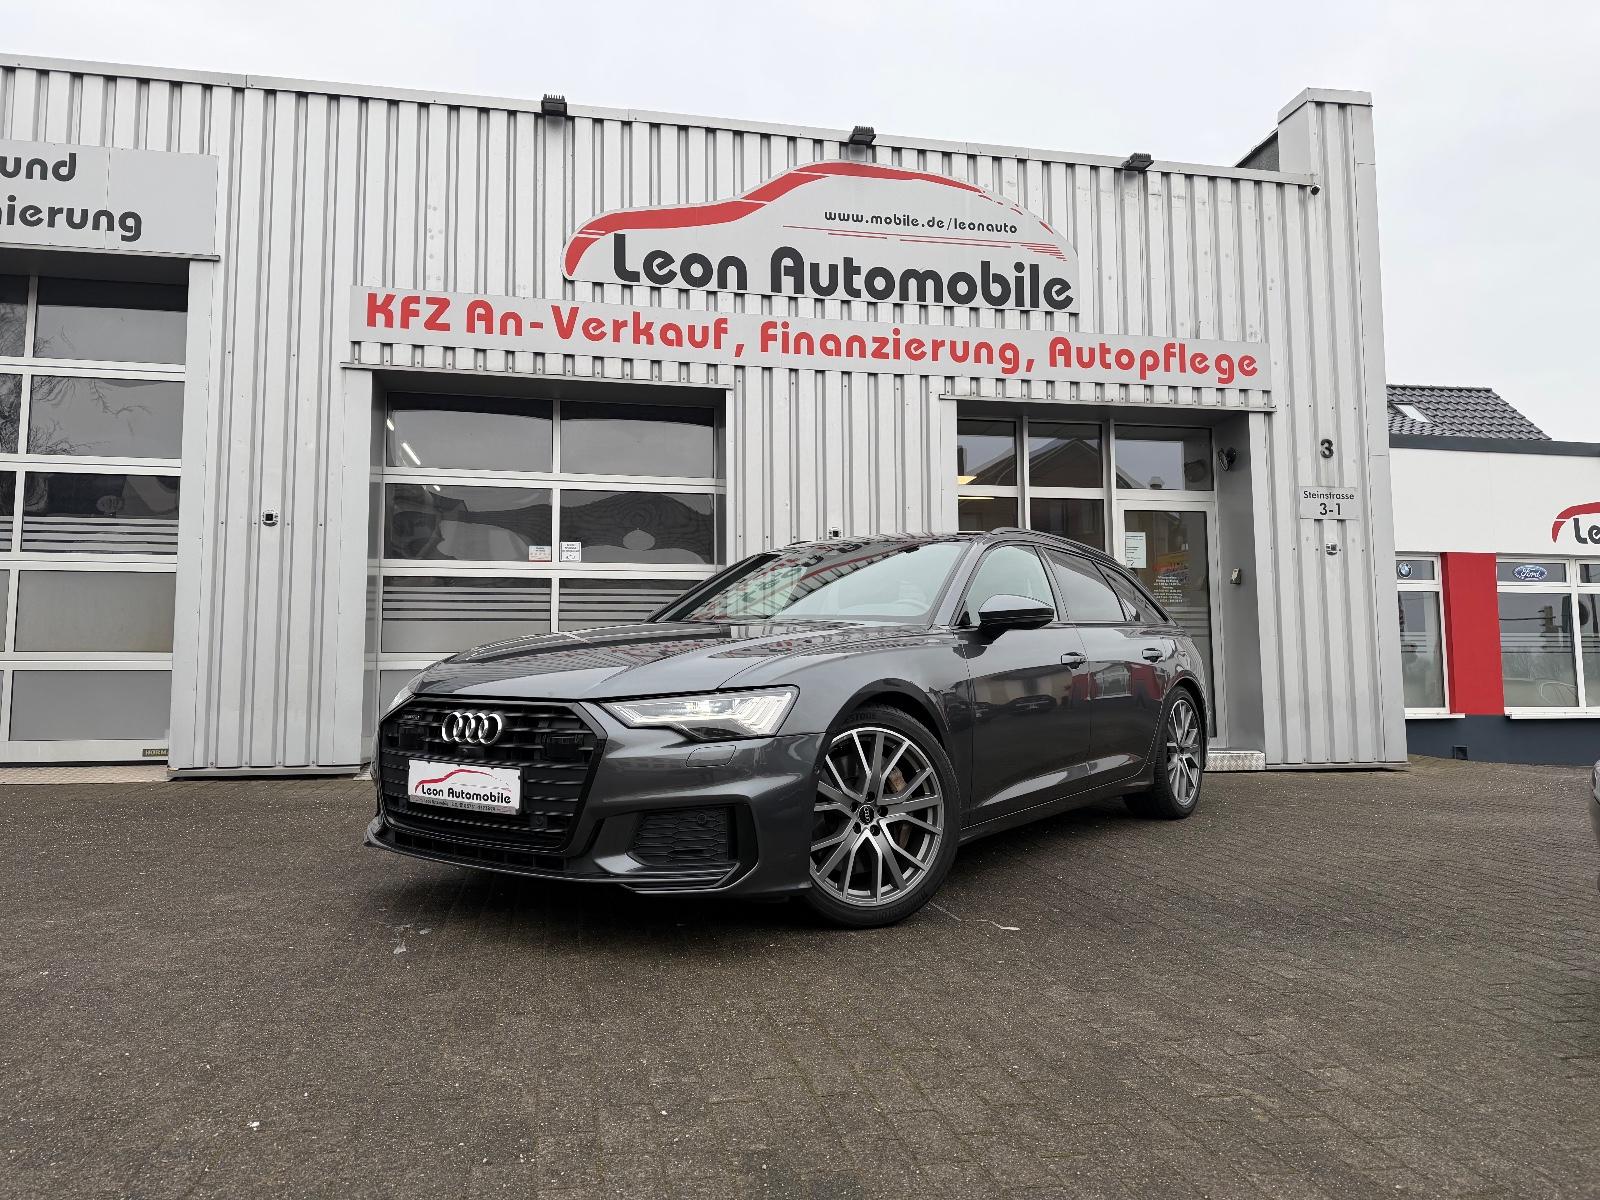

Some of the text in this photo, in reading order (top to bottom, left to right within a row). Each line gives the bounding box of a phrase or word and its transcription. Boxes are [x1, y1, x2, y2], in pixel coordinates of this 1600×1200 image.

[0, 152, 76, 181] und
[0, 194, 142, 242] ierung
[824, 211, 1018, 234] www.mobile.de/leonauto
[613, 232, 1074, 310] Leon Automobile
[366, 292, 1258, 385] KFZ An-Verkauf, Finanzierung, Autopflege
[1319, 438, 1334, 459] 3
[1303, 490, 1355, 500] Steinstrasse
[1319, 502, 1342, 516] 3-1
[421, 785, 512, 804] Leon Automobile
